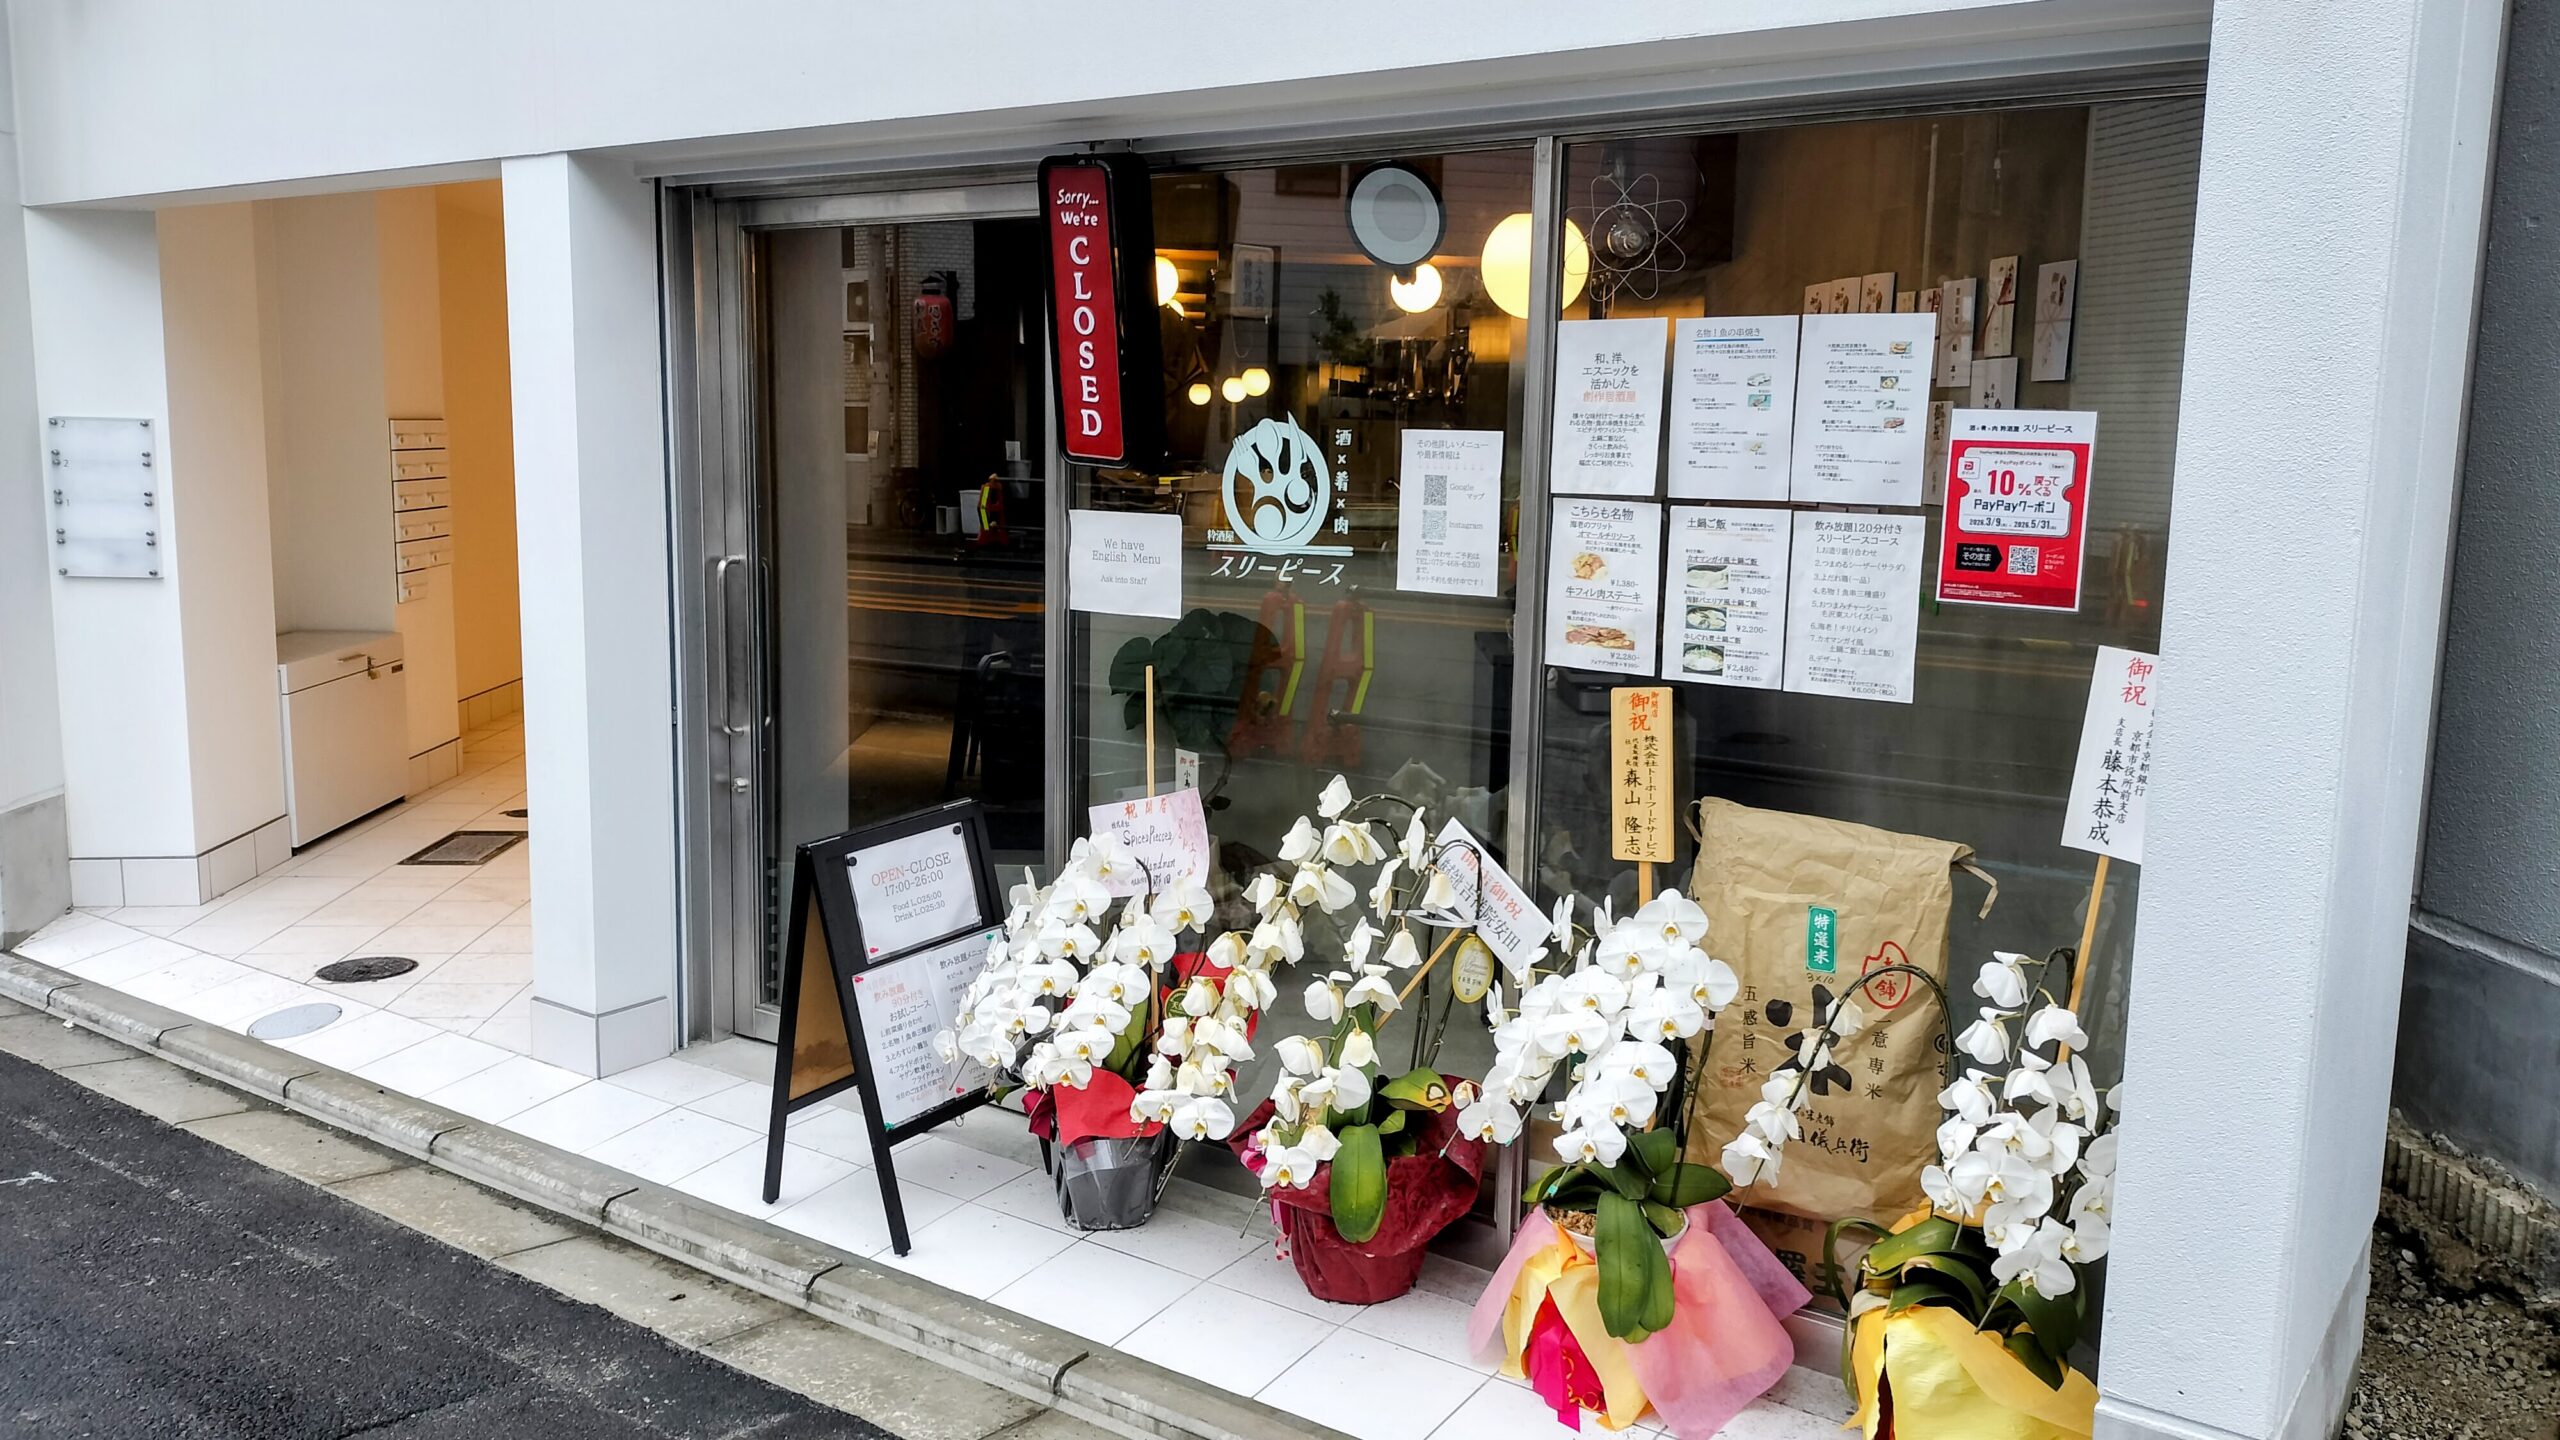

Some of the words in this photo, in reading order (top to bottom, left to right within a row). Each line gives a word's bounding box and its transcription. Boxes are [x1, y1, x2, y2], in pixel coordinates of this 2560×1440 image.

[1056, 189, 1099, 209] Sorry...
[1061, 211, 1098, 226] We're
[1069, 236, 1103, 437] CLOSED
[1696, 327, 1761, 338] 名物！魚の串焼き
[1595, 352, 1626, 364] 和、洋、
[1582, 365, 1639, 376] エスニックを
[1590, 378, 1630, 390] 活かした
[1583, 391, 1636, 403] 創作居酒屋
[2023, 424, 2073, 434] スリーピース
[1417, 440, 1489, 449] その他詳しいメニュー
[1417, 451, 1460, 460] や最新情報は
[1450, 483, 1474, 492] Google
[2033, 475, 2061, 487] 戻って
[2034, 487, 2052, 497] くる
[1571, 506, 1634, 521] こちらも名物
[1974, 498, 2056, 514] PayPayクーポン
[1448, 521, 1483, 530] Instagram
[1687, 517, 1727, 530] 土鍋ご飯
[1815, 520, 1903, 535] 飲み放題120分付き
[1577, 531, 1636, 542] オマールチリソース
[1817, 534, 1900, 546] スリーピースコース
[1104, 538, 1118, 549] We
[1121, 540, 1145, 551] have
[1092, 550, 1127, 563] English
[1133, 553, 1161, 565] Menu
[1962, 552, 1992, 561] そのまま
[1210, 556, 1345, 586] スリーピース
[1101, 575, 1114, 583] Ask
[1129, 576, 1148, 585] Staff
[1566, 586, 1641, 602] 牛フィレ肉ステーキ
[2121, 656, 2153, 706] 御祝
[1629, 692, 1651, 731] 御祝
[2113, 717, 2126, 748] 支店長
[2114, 730, 2144, 824] 京都市役所前支店
[1623, 768, 1643, 806] 森山
[1642, 735, 1659, 858] 株式会社トーホーフードサービス
[2087, 749, 2125, 846] 藤本恭成
[1624, 816, 1643, 856] 隆志
[871, 852, 951, 887] OPEN-CLOSE
[884, 869, 944, 897] 17:00-26:00
[893, 901, 910, 913] Food
[894, 911, 914, 923] Drink
[1813, 913, 1831, 965] 特選米
[890, 999, 932, 1022] お試しコース
[1740, 985, 1759, 1074] 五感旨米
[1864, 1018, 1893, 1101] 一意専米
